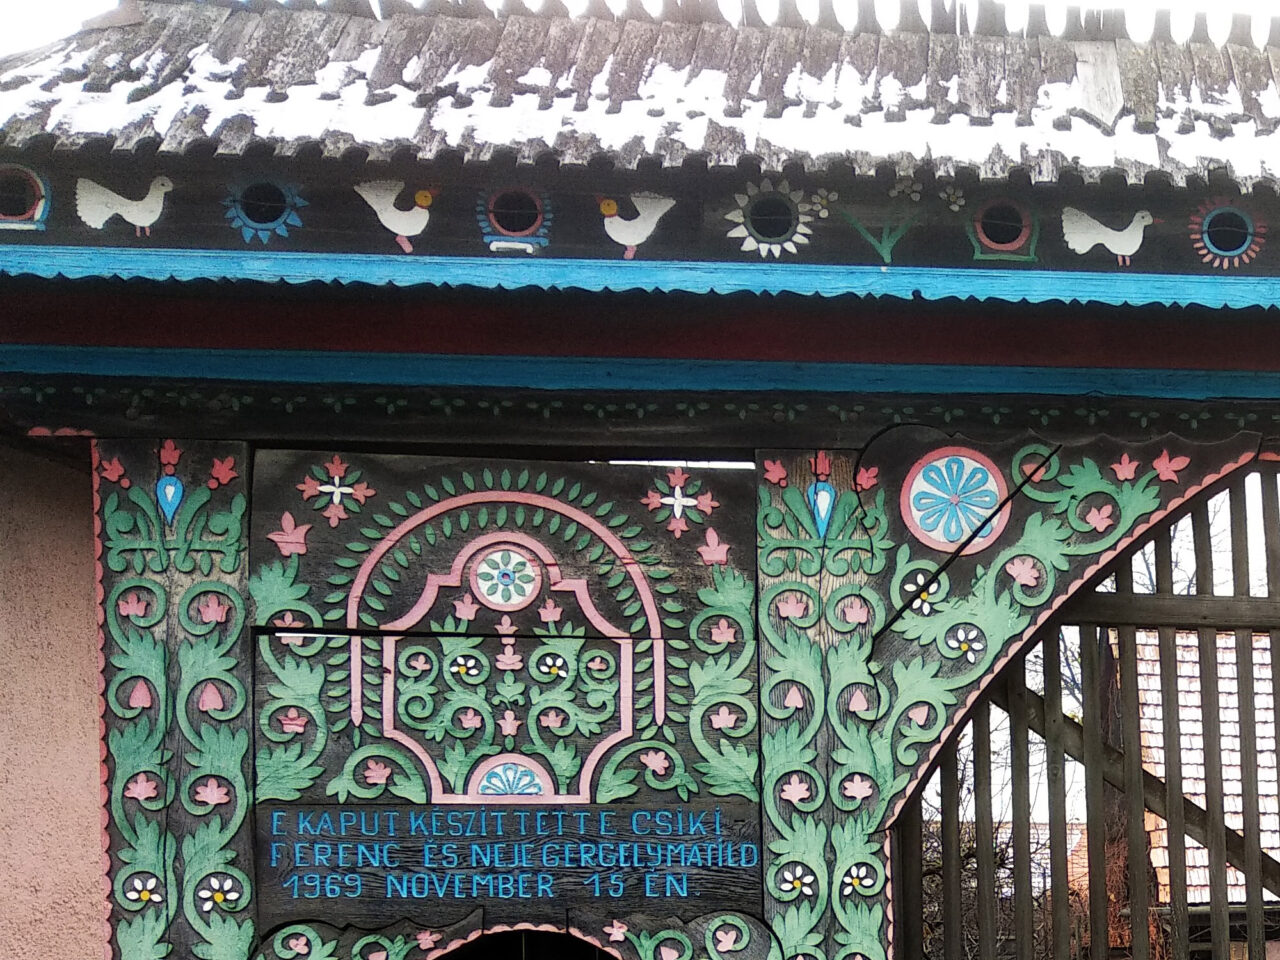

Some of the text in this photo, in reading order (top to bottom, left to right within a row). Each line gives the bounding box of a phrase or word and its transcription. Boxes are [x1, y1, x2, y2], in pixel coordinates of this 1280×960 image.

[270, 809, 287, 837] E
[298, 809, 400, 838] KAPUT
[269, 841, 400, 869] FERENC
[470, 841, 535, 869] NEJE
[282, 872, 363, 900] 1969
[385, 872, 555, 900] NOVEMBER
[583, 871, 626, 899] 15
